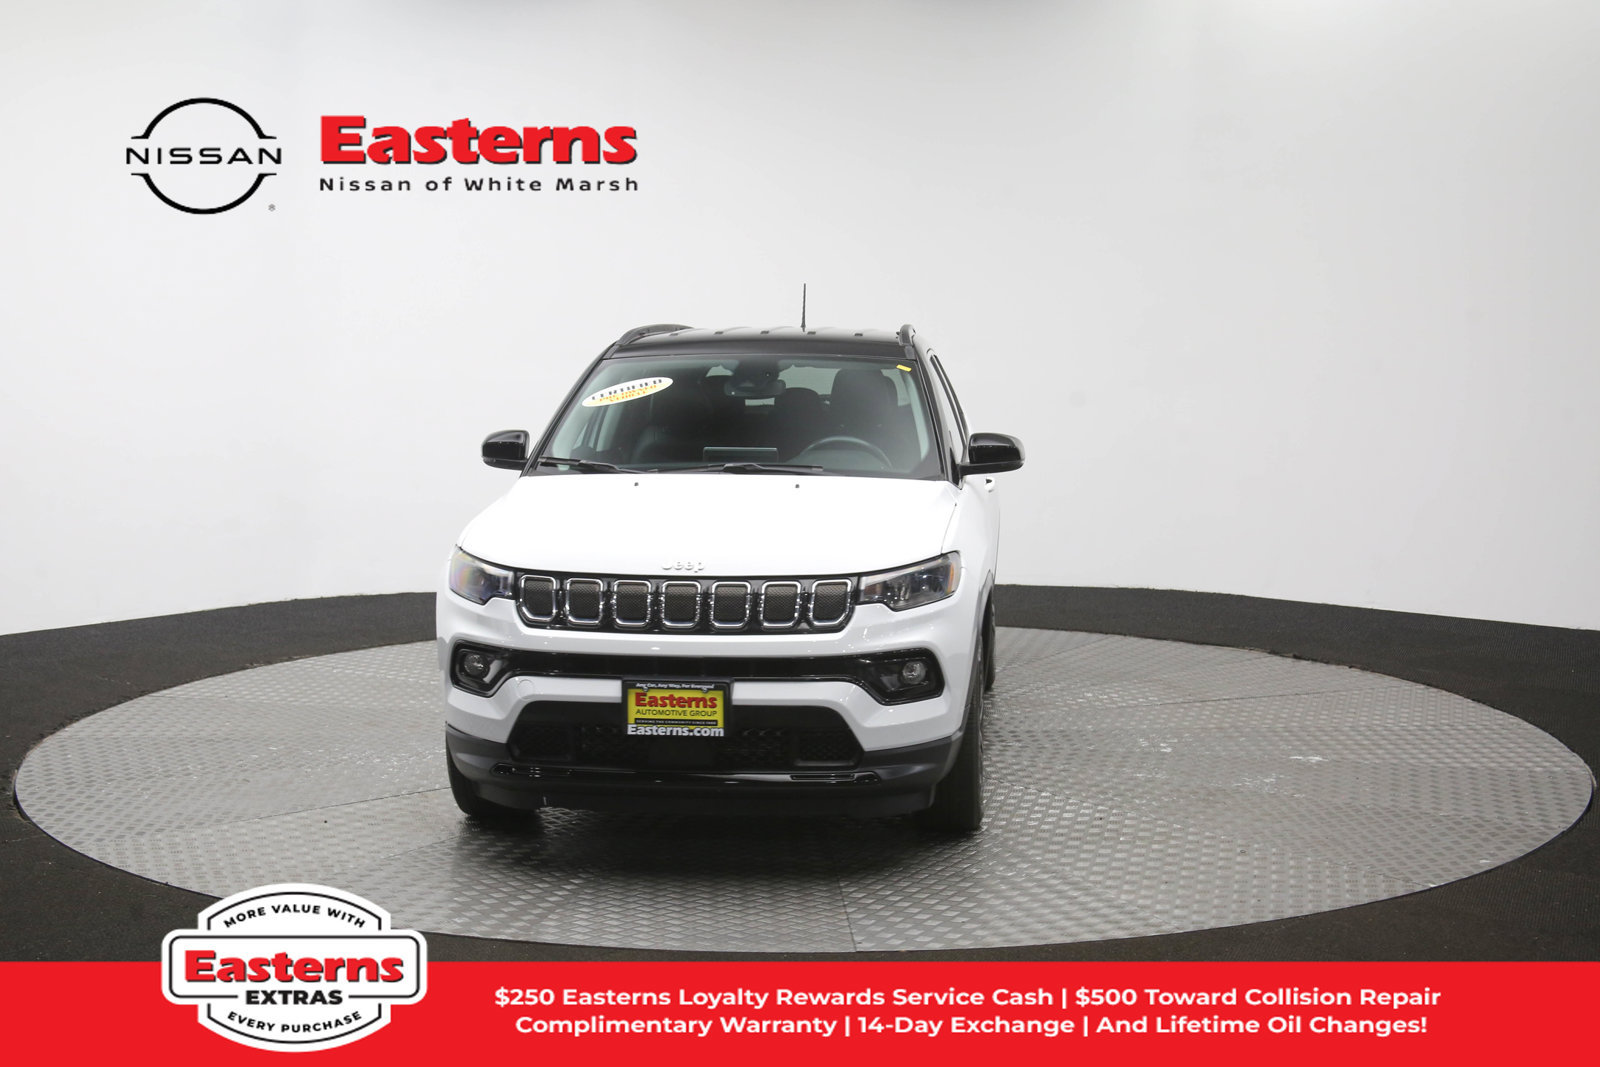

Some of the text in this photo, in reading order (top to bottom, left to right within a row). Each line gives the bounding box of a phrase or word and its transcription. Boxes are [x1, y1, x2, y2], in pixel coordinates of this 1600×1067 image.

[635, 693, 717, 708] Easterns
[635, 709, 688, 717] AUTOMOTIVE
[627, 724, 724, 737] Easterns.com
